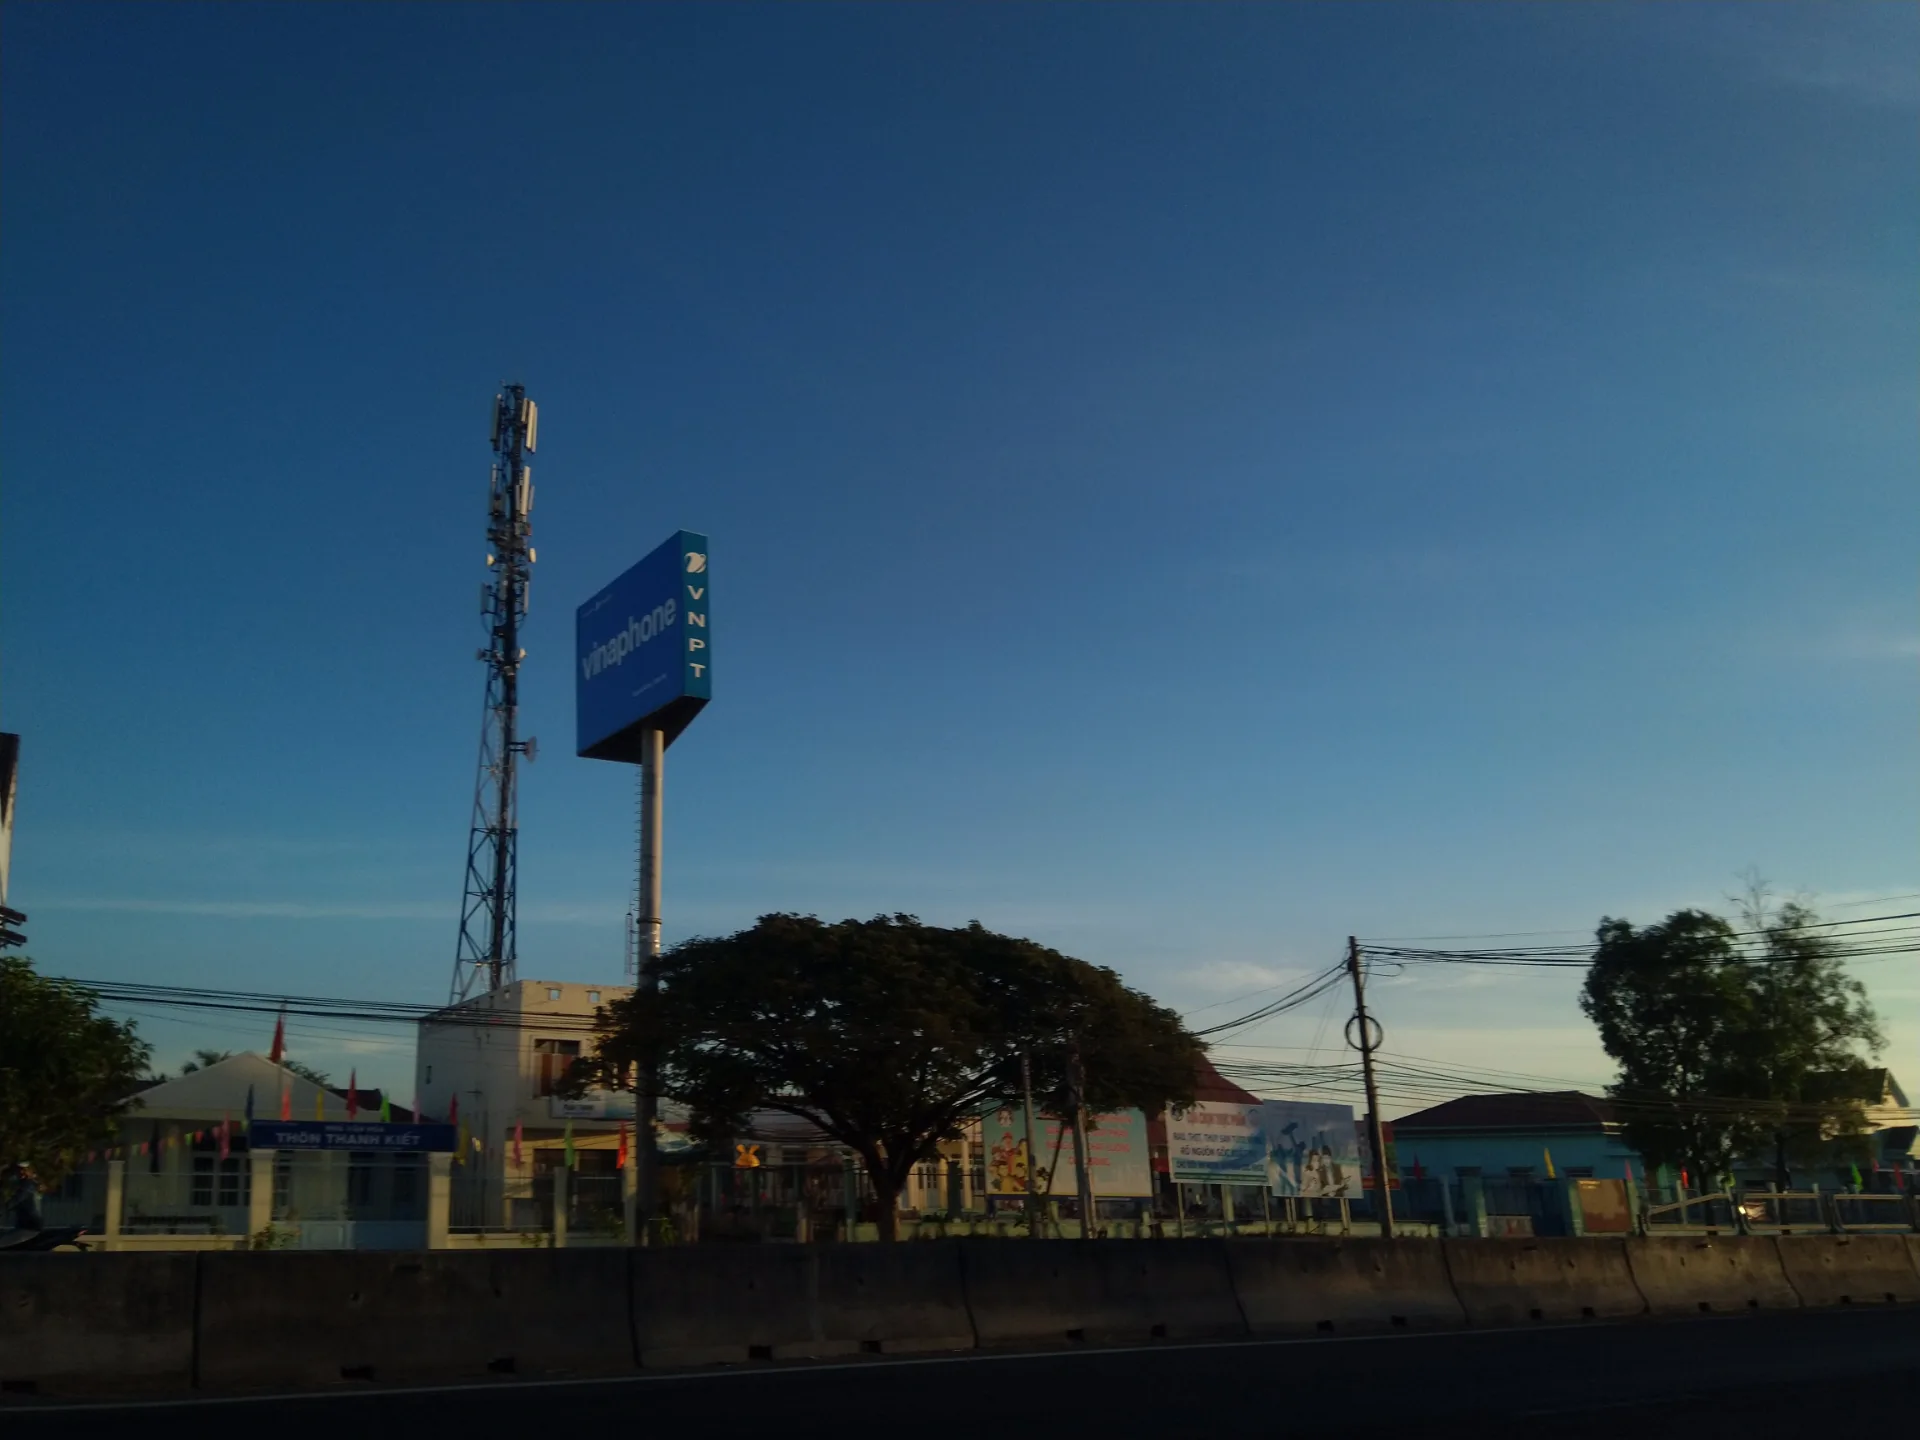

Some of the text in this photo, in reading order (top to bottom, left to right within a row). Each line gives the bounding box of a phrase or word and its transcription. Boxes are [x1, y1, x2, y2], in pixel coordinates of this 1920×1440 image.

[582, 598, 677, 680] vinaphone
[687, 584, 706, 678] VNPT
[276, 1131, 321, 1144] THÔN
[326, 1133, 380, 1145] THANH
